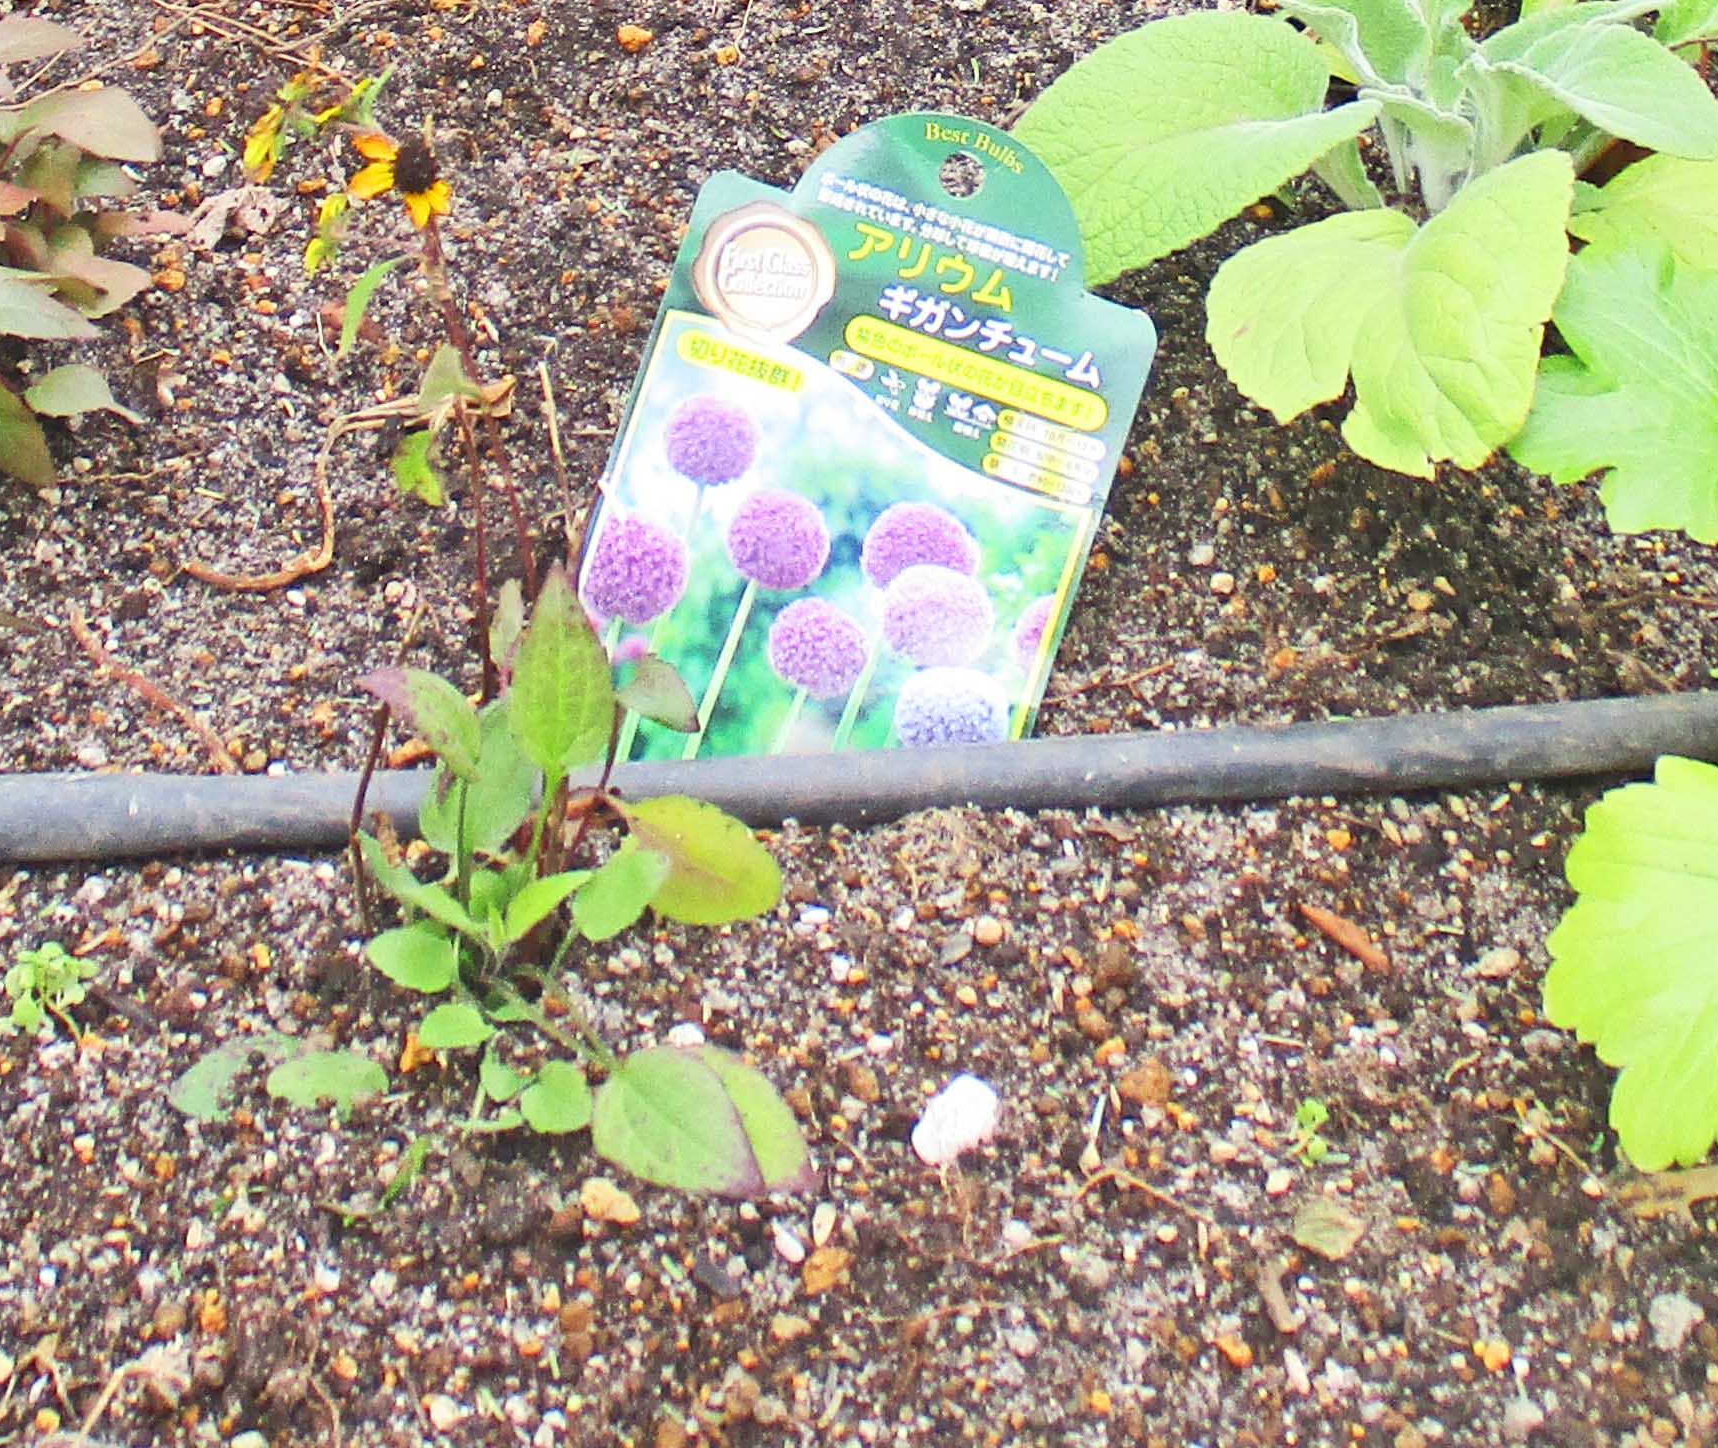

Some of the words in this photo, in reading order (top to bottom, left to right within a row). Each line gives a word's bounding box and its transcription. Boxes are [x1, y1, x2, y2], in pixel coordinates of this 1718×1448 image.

[925, 123, 970, 144] Best
[974, 132, 1025, 174] Bulbs
[848, 222, 1014, 312] アリウム
[879, 285, 1100, 388] ギガンチューム
